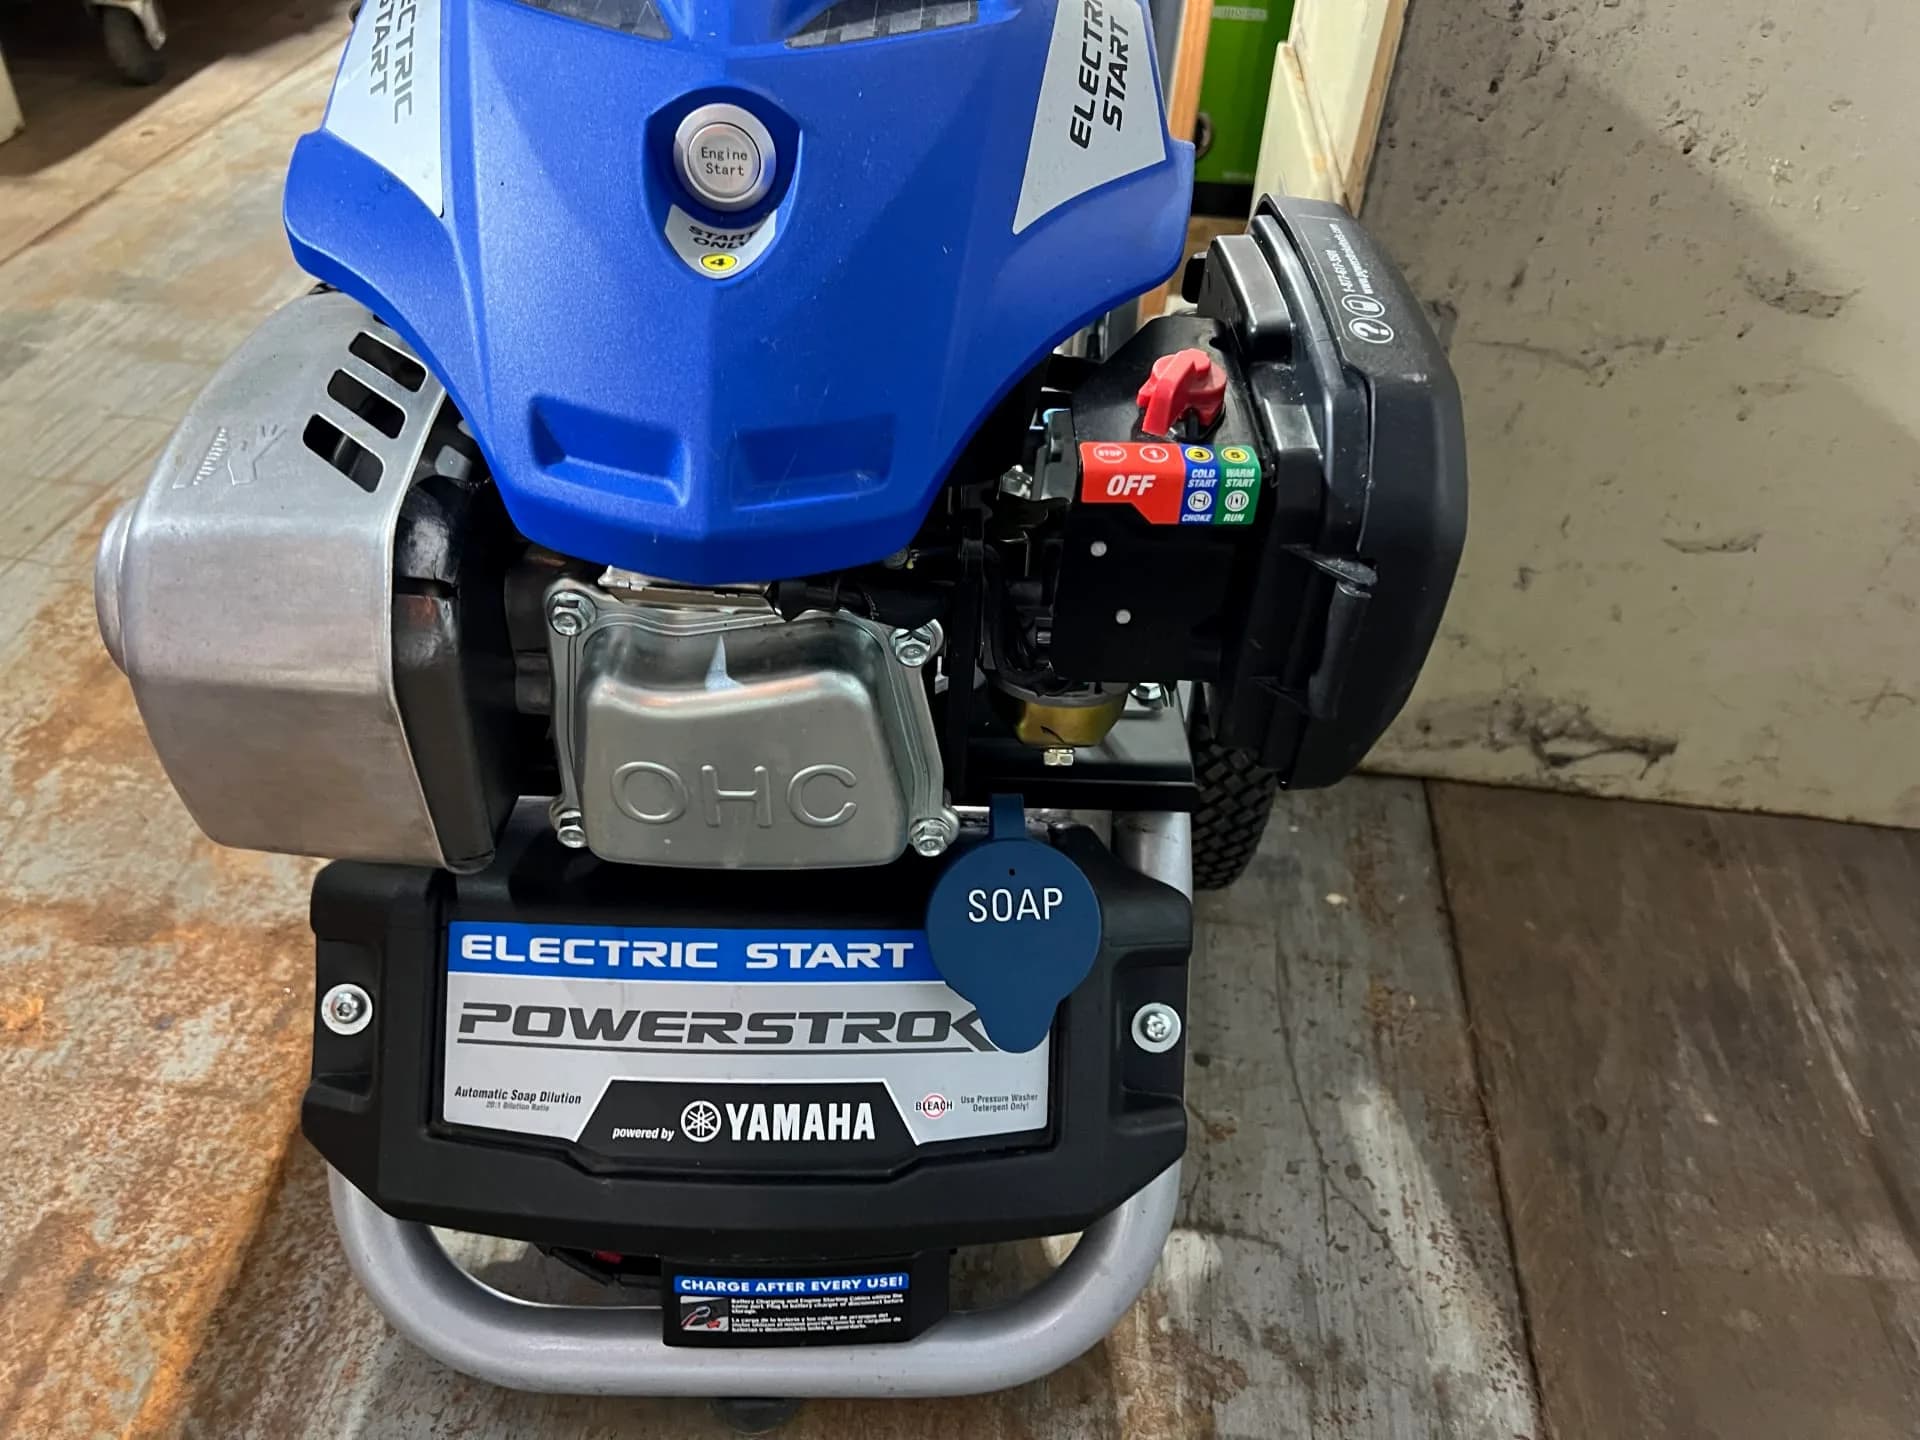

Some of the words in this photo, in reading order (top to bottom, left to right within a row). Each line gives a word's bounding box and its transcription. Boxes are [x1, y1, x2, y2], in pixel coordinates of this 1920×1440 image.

[1103, 15, 1128, 132] START
[701, 146, 748, 161] Engine
[705, 162, 745, 177] Start
[688, 224, 759, 243] START
[710, 257, 726, 267] 4
[1098, 446, 1122, 458] STOP
[1150, 448, 1159, 459] 1
[1193, 450, 1204, 460] 3
[1230, 450, 1241, 460] 5
[1191, 469, 1216, 479] COLD
[1225, 468, 1256, 478] WARM
[1107, 474, 1157, 497] OFF
[1187, 478, 1218, 488] START
[1225, 478, 1255, 488] START
[1182, 514, 1213, 523] CHOKE
[1223, 514, 1245, 522] RUN
[611, 761, 858, 829] OHC
[967, 887, 1064, 923] SOAP
[461, 934, 719, 969] ELECTRIC
[745, 943, 915, 969] START
[454, 1085, 509, 1101] Automatic
[510, 1089, 537, 1105] Soap
[539, 1090, 582, 1105] Dilution
[960, 1095, 975, 1104] Use
[976, 1094, 1009, 1104] Pressure
[1010, 1093, 1039, 1103] Washer
[914, 1100, 954, 1112] BLEACH
[972, 1102, 1009, 1113] Detergent
[1010, 1102, 1030, 1112] Only!
[612, 1127, 658, 1141] powered
[660, 1128, 675, 1142] by
[725, 1102, 876, 1141] YAMAHA
[680, 1279, 750, 1292] CHARGE
[755, 1280, 805, 1293] AFTER
[811, 1277, 861, 1291] EVERY
[866, 1275, 904, 1288] USE!
